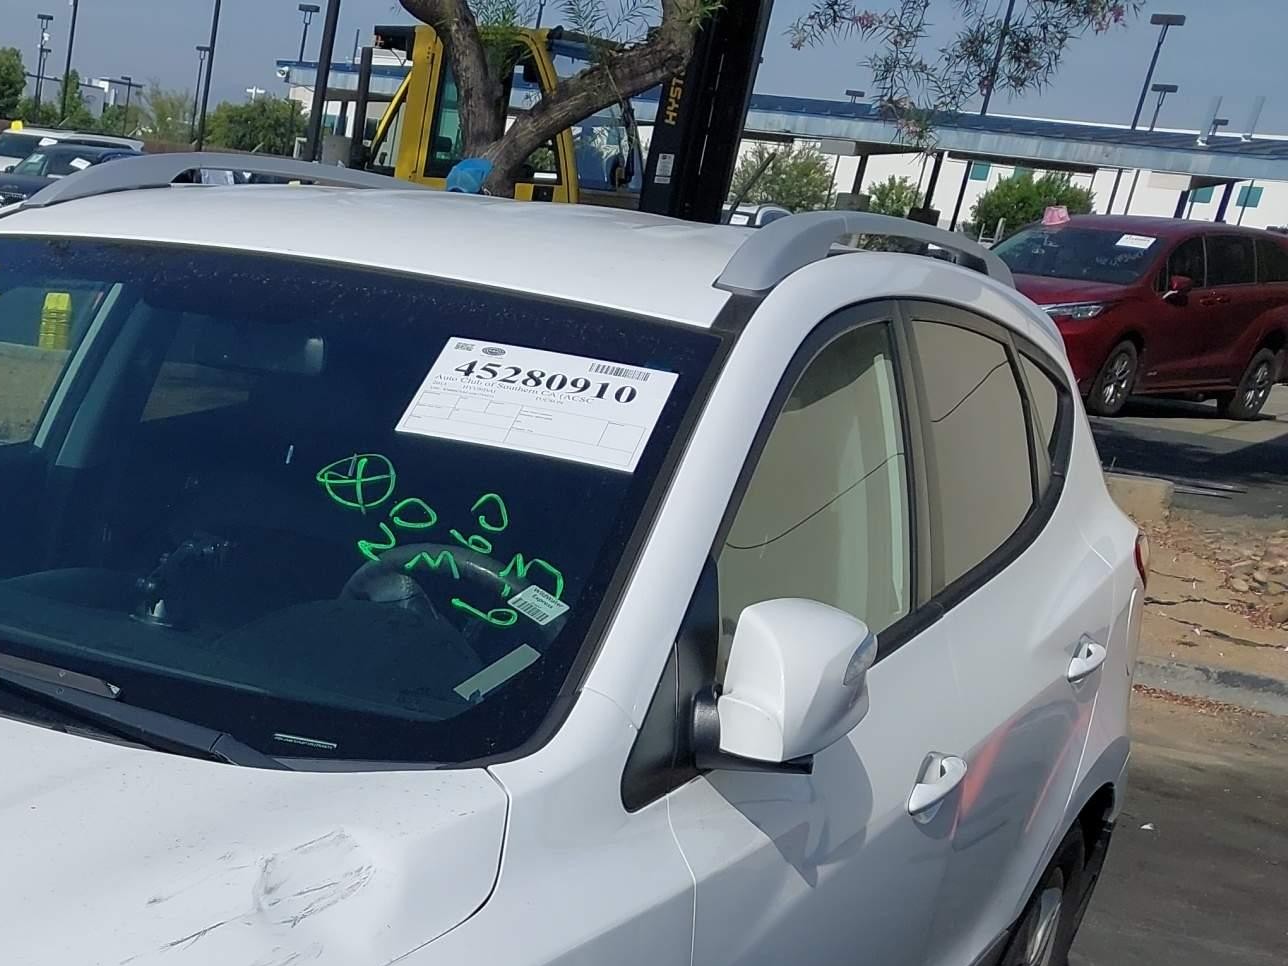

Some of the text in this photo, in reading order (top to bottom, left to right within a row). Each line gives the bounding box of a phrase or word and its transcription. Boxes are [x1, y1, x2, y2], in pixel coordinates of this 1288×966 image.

[664, 70, 685, 125] HYST
[454, 359, 638, 404] 45280910
[460, 375, 483, 385] Club
[496, 382, 539, 395] Southern
